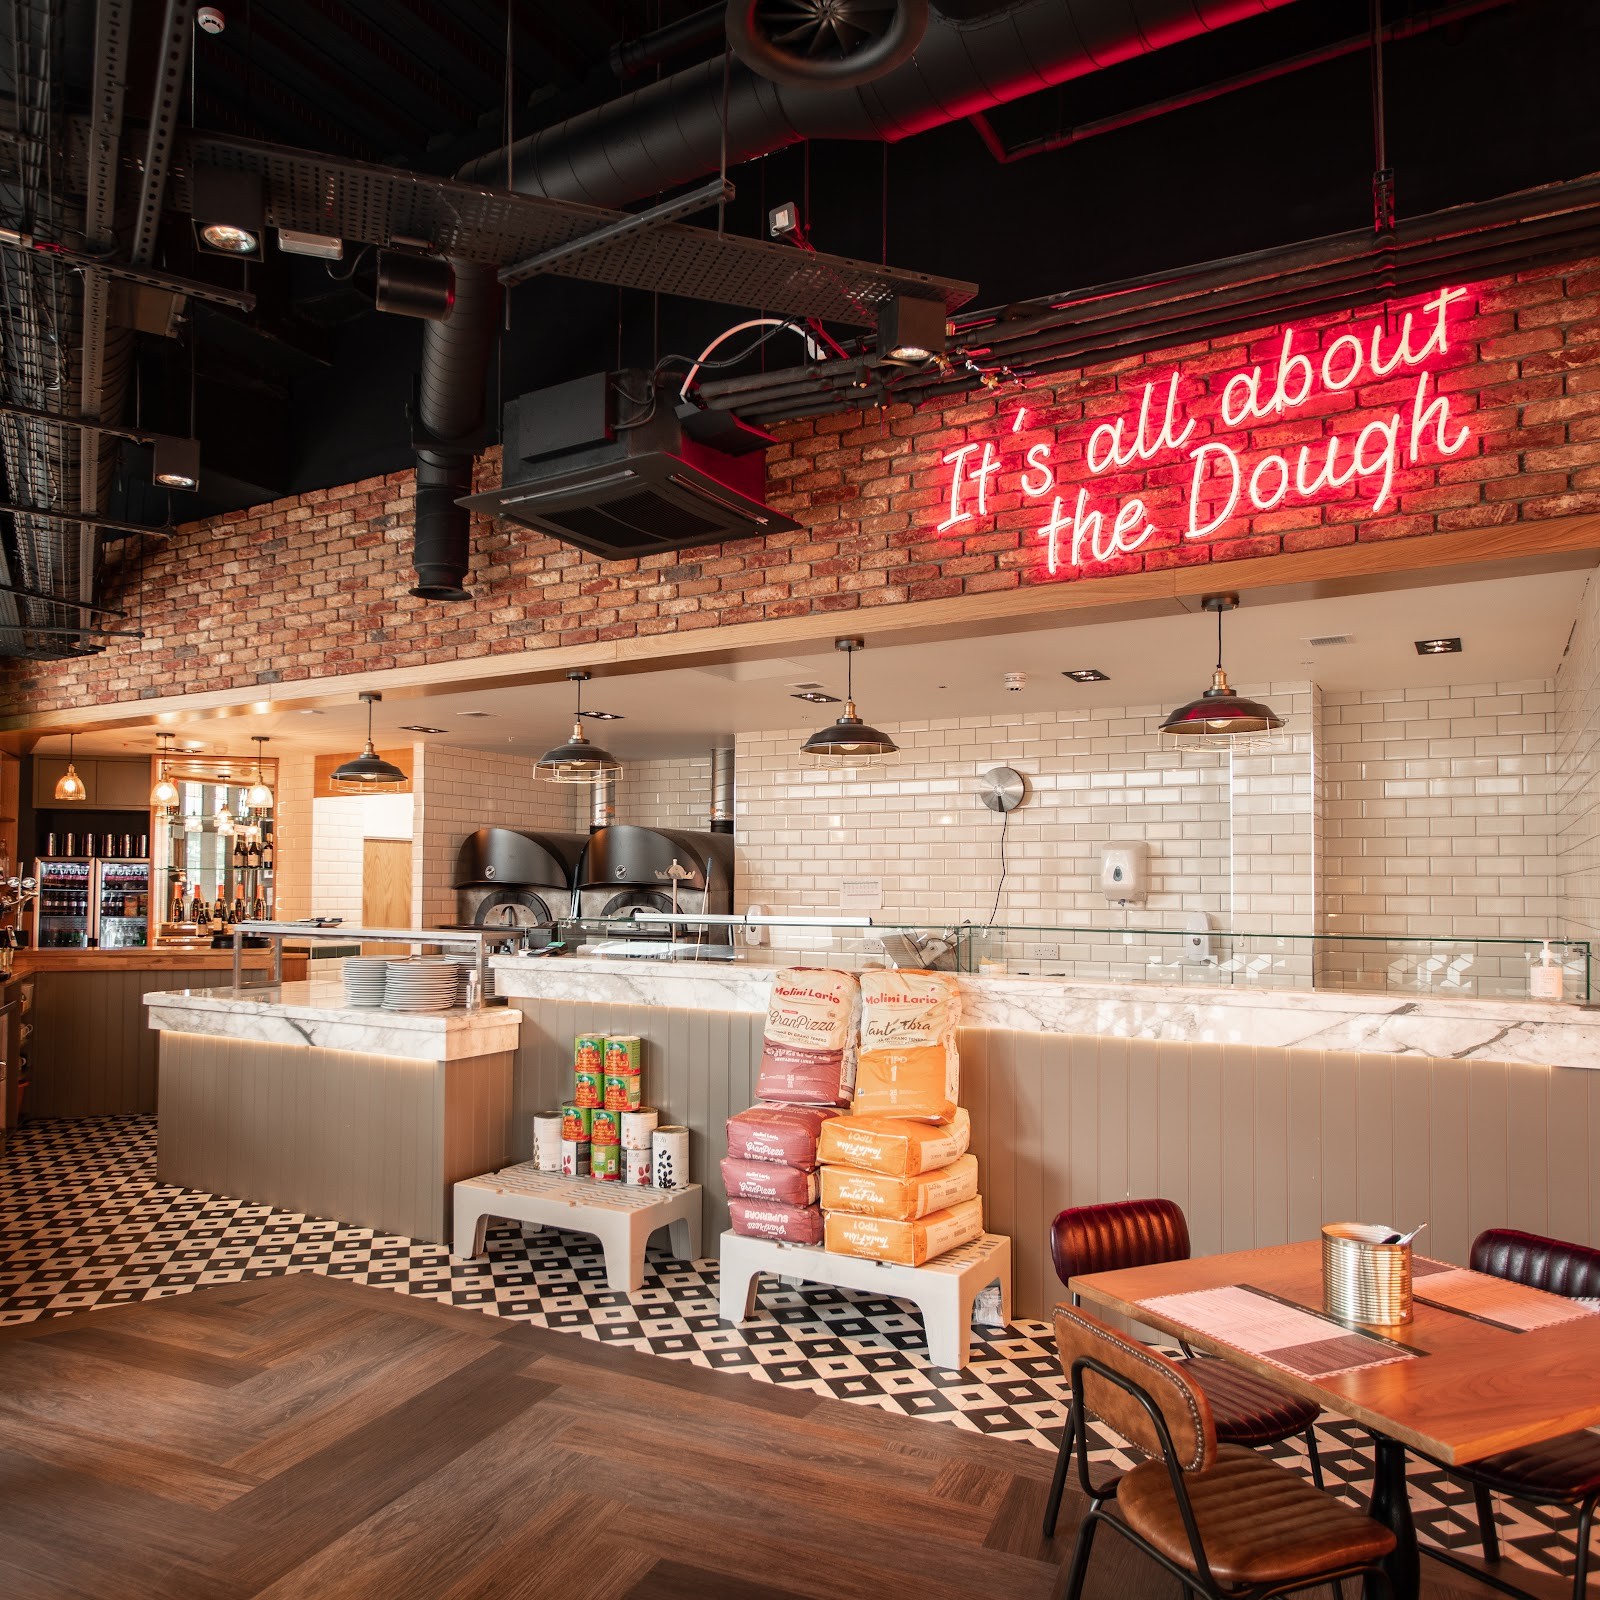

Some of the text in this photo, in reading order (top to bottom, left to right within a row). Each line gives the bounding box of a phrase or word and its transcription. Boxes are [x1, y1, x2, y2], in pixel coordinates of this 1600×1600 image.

[938, 287, 1467, 533] It's all about
[1037, 371, 1470, 574] the Dough
[775, 987, 840, 1004] Molini Lario
[865, 992, 938, 1005] Molini Lario
[883, 1055, 908, 1065] TIPO
[890, 1065, 898, 1082] 1
[744, 1209, 789, 1223] SUPERIORE
